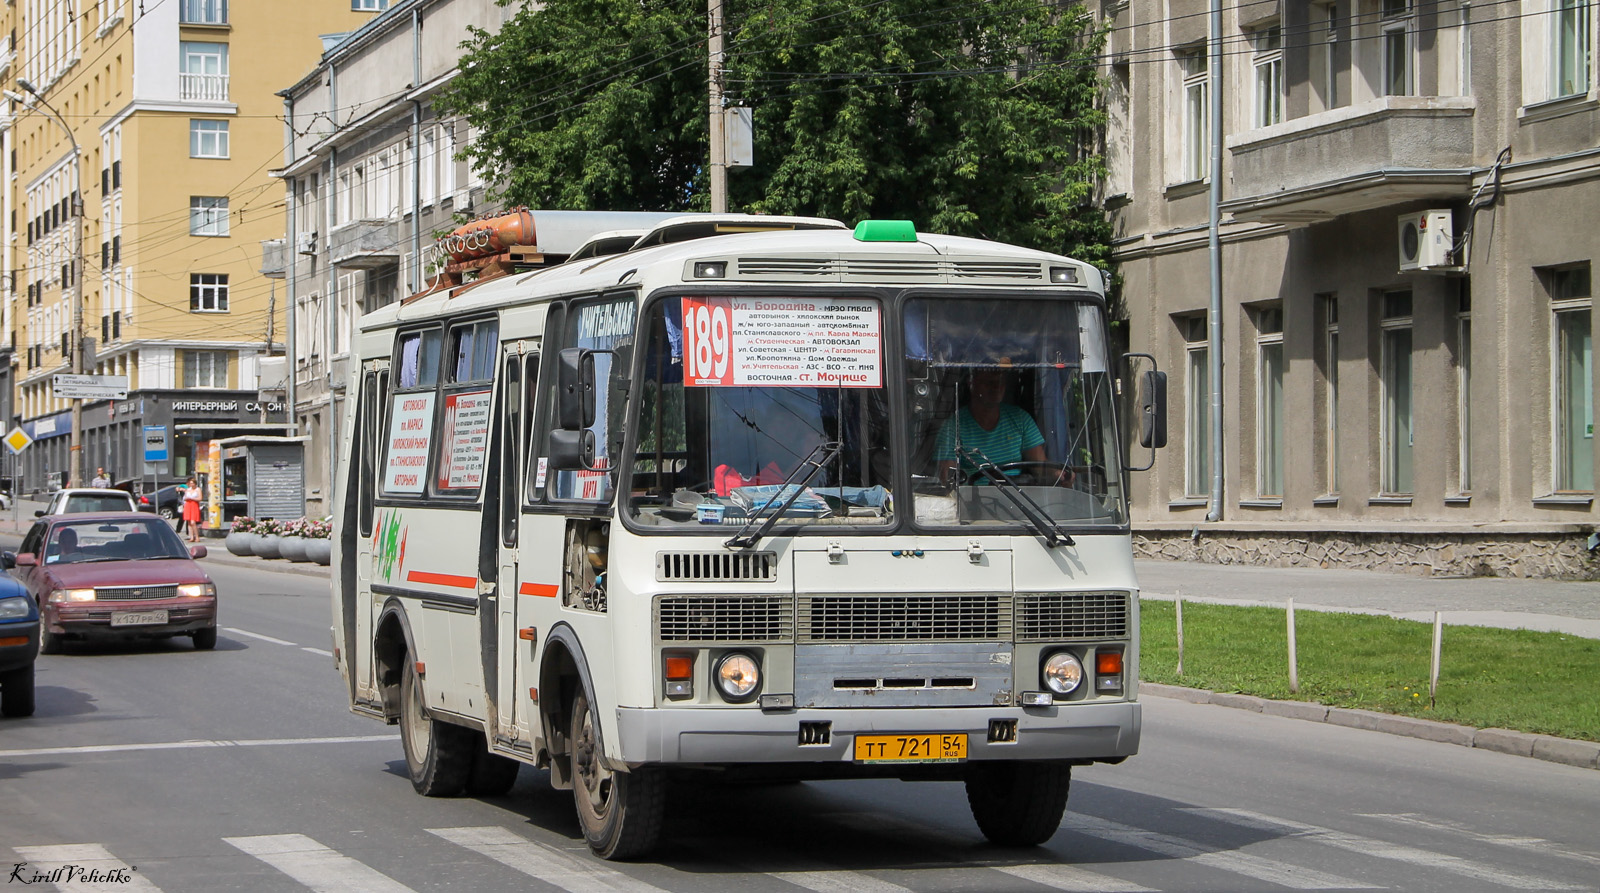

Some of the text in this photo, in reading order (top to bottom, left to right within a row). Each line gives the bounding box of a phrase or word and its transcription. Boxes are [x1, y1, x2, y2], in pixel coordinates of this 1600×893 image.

[734, 302, 750, 312] ул.
[754, 302, 815, 312] Бородина
[580, 302, 634, 339] УЧИТЕЛЬСКАЯ
[686, 306, 729, 378] 189
[172, 401, 282, 412] ИНТЕРЬЕРНЫЙ САОН
[402, 399, 427, 411] АВТОВОКЗАЛ
[407, 418, 423, 431] МАРКСА
[396, 456, 426, 467] СТАНИСЛАВСКОГО
[394, 474, 418, 486] АВТОРЫНОК
[866, 736, 960, 757] ТТ 721 54
